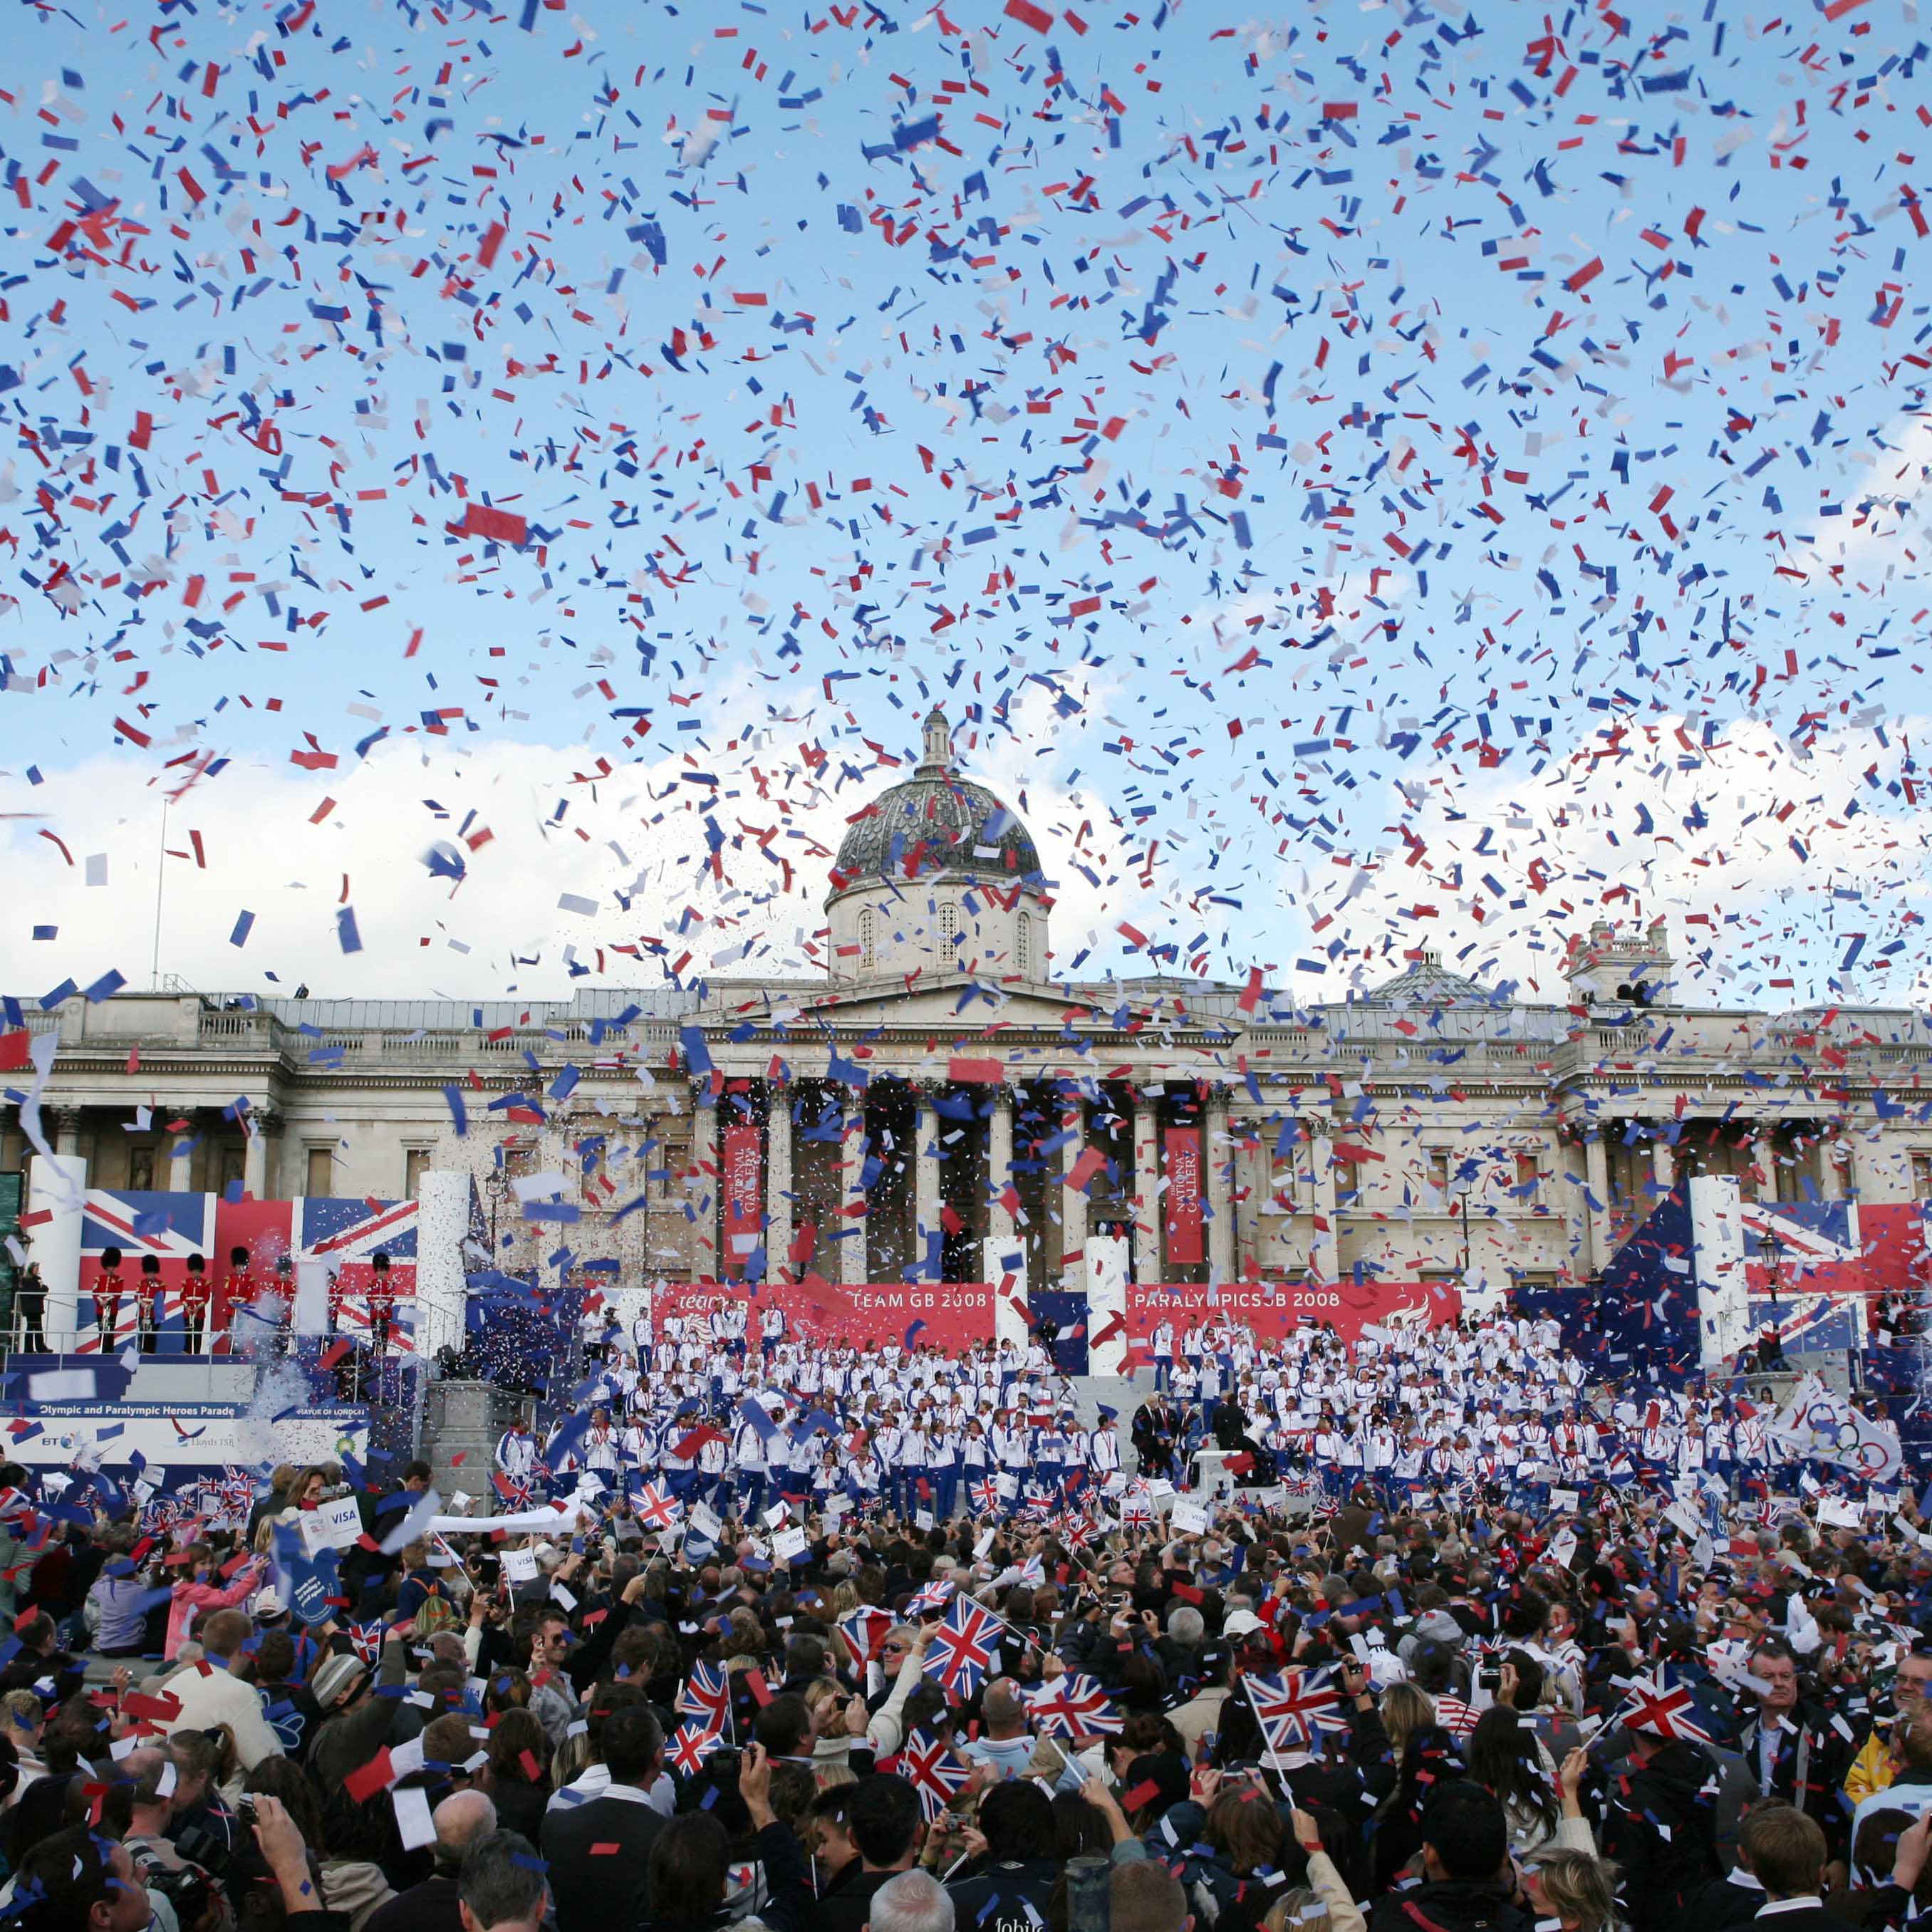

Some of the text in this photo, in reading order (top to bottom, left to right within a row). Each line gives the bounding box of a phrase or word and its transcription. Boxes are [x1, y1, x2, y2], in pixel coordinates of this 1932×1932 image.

[734, 1148, 744, 1211] ATIONAL
[744, 1148, 755, 1212] GALERY
[851, 1293, 987, 1308] TEAM GB 2008
[1292, 1293, 1340, 1307] 2008
[40, 1405, 235, 1417] Olympic and Paralympic Heroes Parade
[42, 1438, 58, 1446] BT
[331, 1510, 355, 1524] VISA
[709, 1518, 720, 1529] VISA
[1191, 1513, 1205, 1523] VISA
[788, 1532, 802, 1544] VISA
[517, 1555, 534, 1566] VISA
[996, 1917, 1044, 1931] obil
